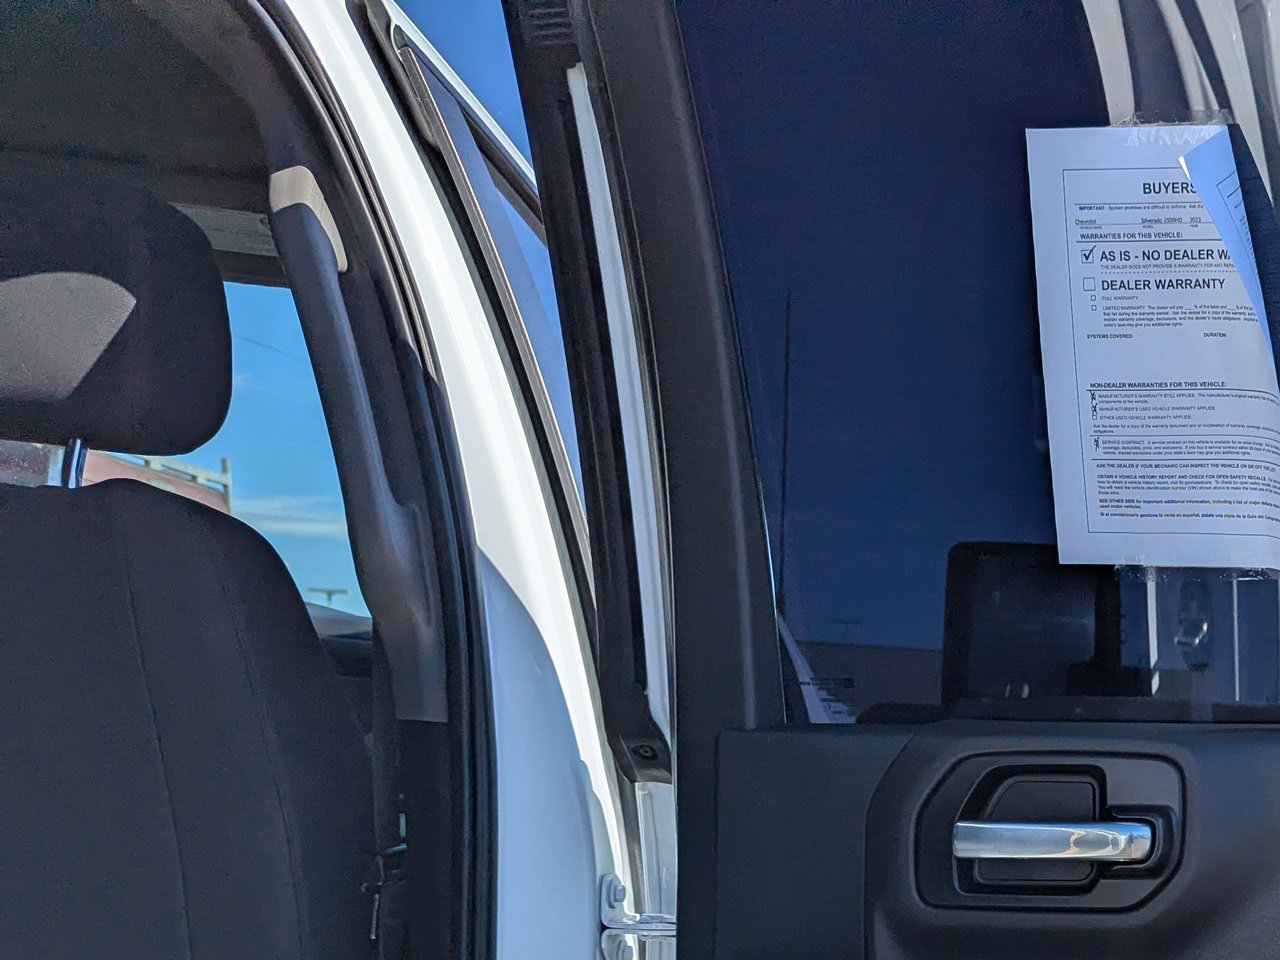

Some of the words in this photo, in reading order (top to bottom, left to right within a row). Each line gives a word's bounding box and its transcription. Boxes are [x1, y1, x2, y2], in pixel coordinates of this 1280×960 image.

[1100, 251, 1116, 262] AS
[1120, 250, 1131, 261] IS
[1142, 250, 1160, 261] NO
[1164, 249, 1214, 261] DEALER
[1102, 280, 1151, 291] DEALER
[1154, 278, 1225, 290] WARRANTY
